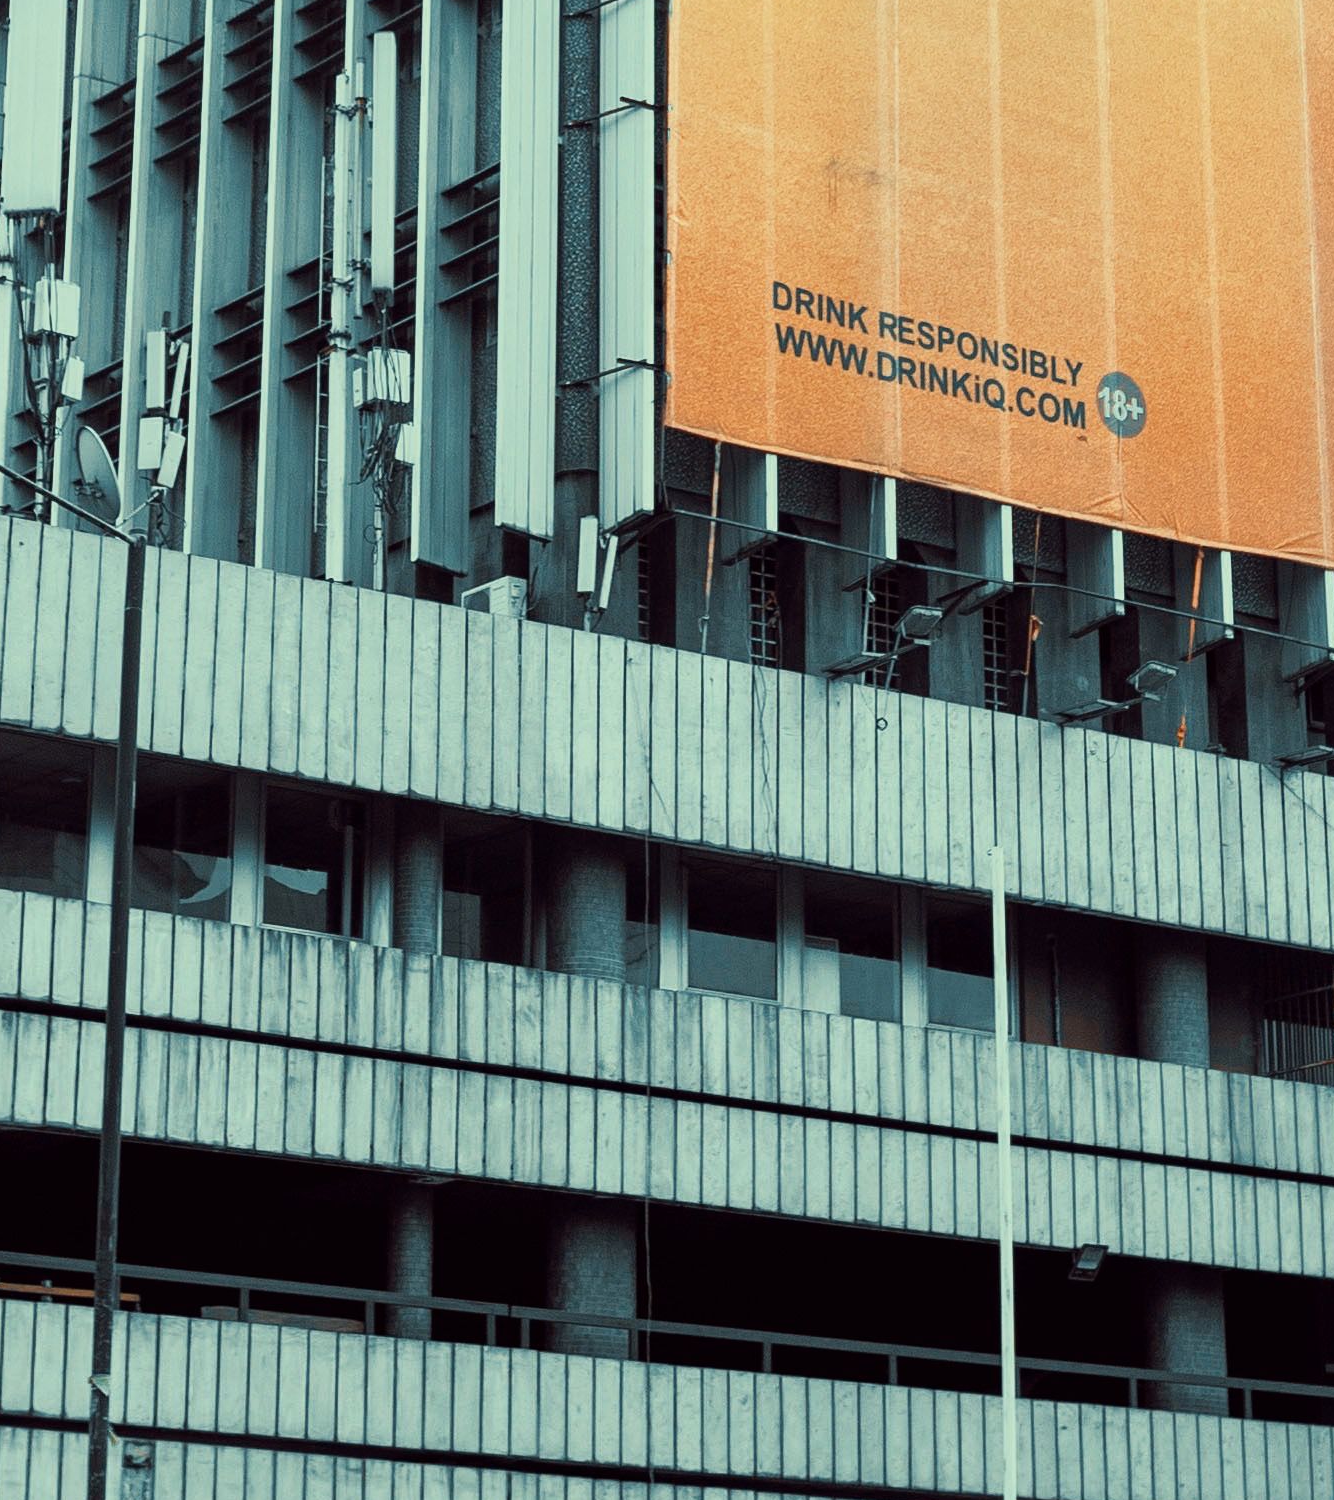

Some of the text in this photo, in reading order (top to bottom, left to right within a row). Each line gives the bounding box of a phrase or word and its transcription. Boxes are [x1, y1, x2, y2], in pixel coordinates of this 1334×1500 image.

[771, 280, 1083, 388] DRINK RESPONSIBLY
[1097, 385, 1144, 423] 18+
